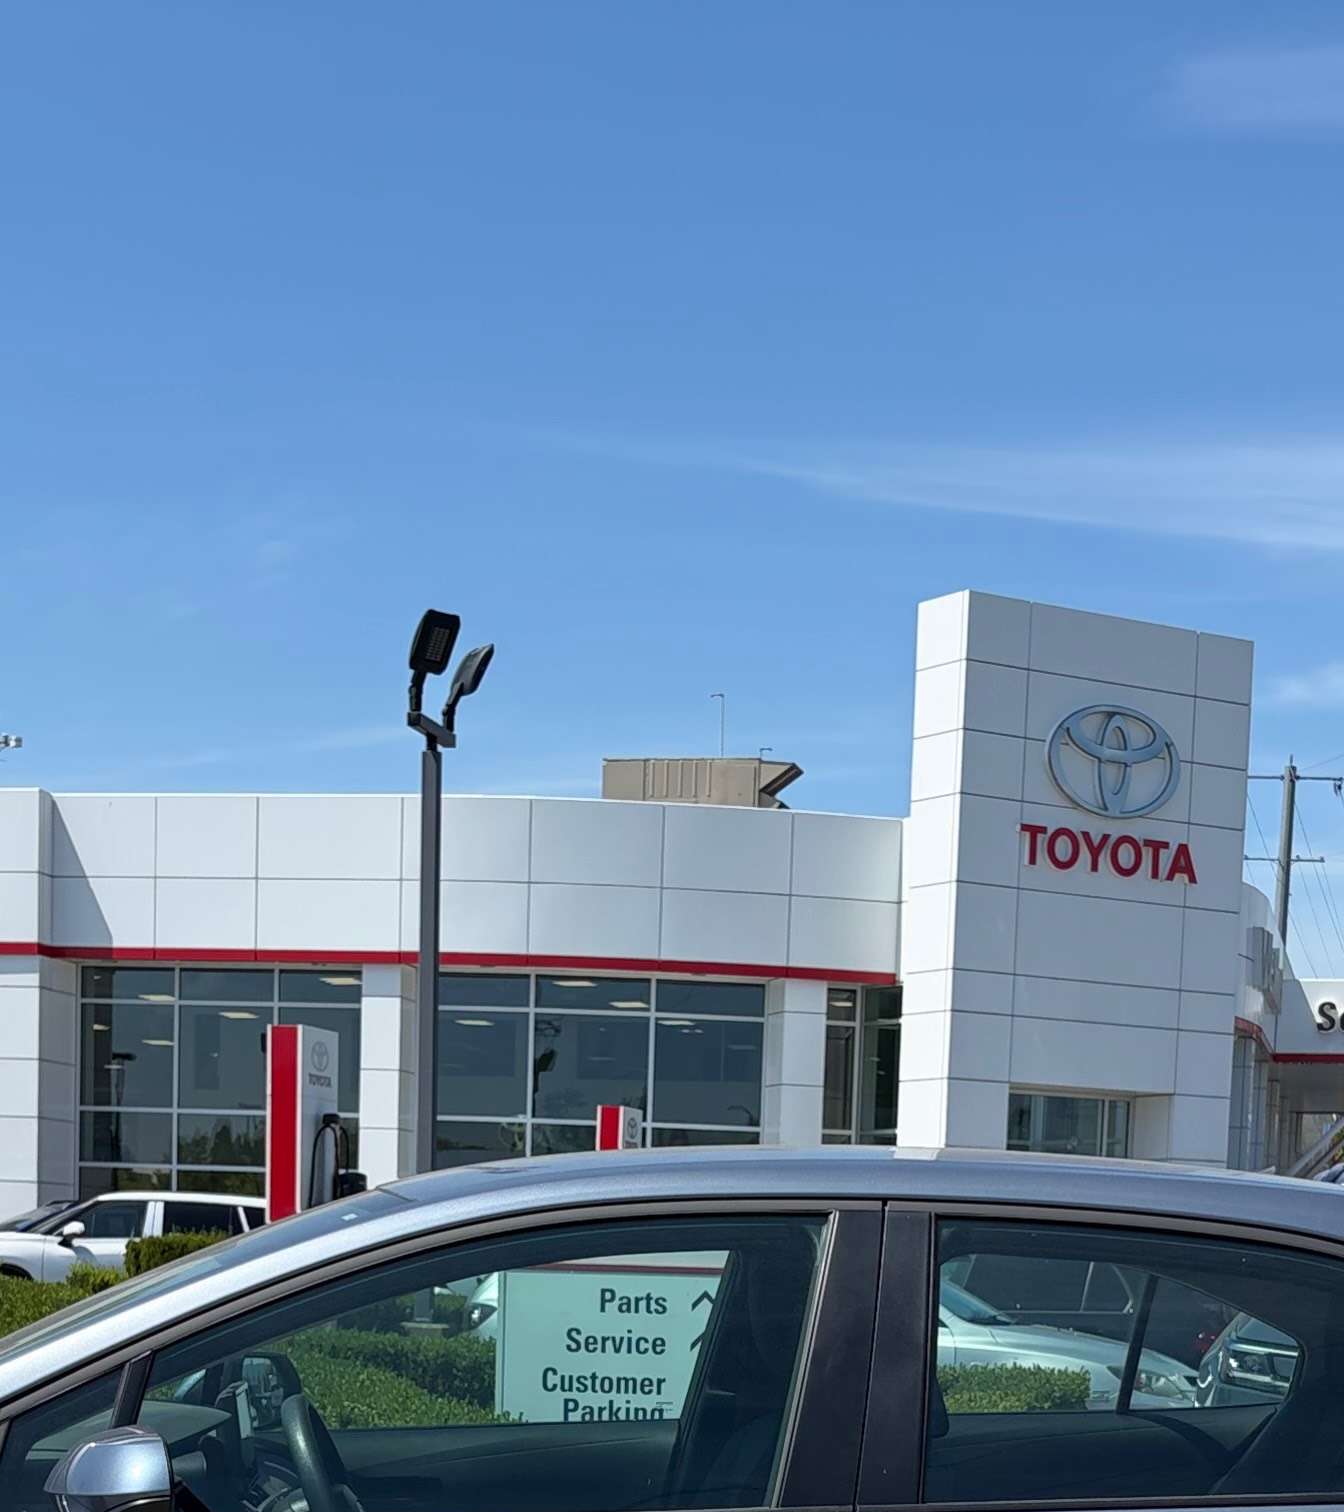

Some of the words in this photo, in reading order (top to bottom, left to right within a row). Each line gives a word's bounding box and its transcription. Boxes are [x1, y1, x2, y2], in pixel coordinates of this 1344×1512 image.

[1019, 823, 1198, 884] TOYOTA
[599, 1287, 668, 1315] Parts
[565, 1327, 667, 1355] Service
[541, 1366, 667, 1396] Customer
